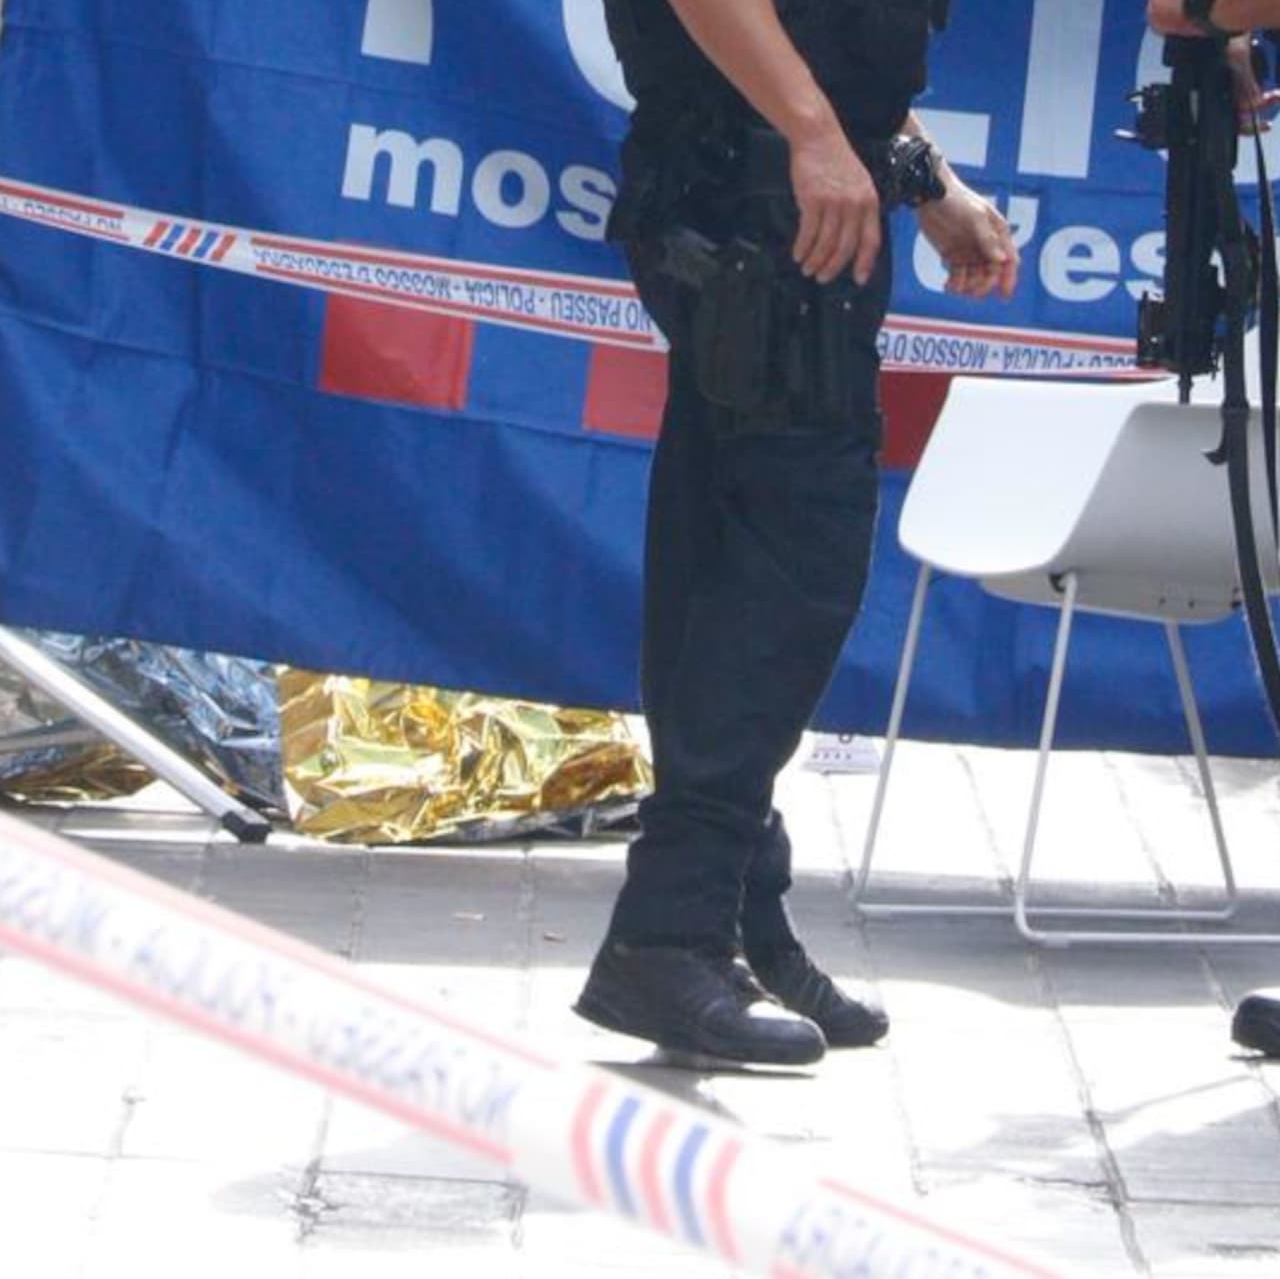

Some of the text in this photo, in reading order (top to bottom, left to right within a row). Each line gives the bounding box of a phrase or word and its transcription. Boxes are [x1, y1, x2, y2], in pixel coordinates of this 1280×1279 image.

[463, 280, 536, 313] POLICIA
[551, 292, 620, 326] PASSEU
[911, 335, 989, 370] MOSSOS
